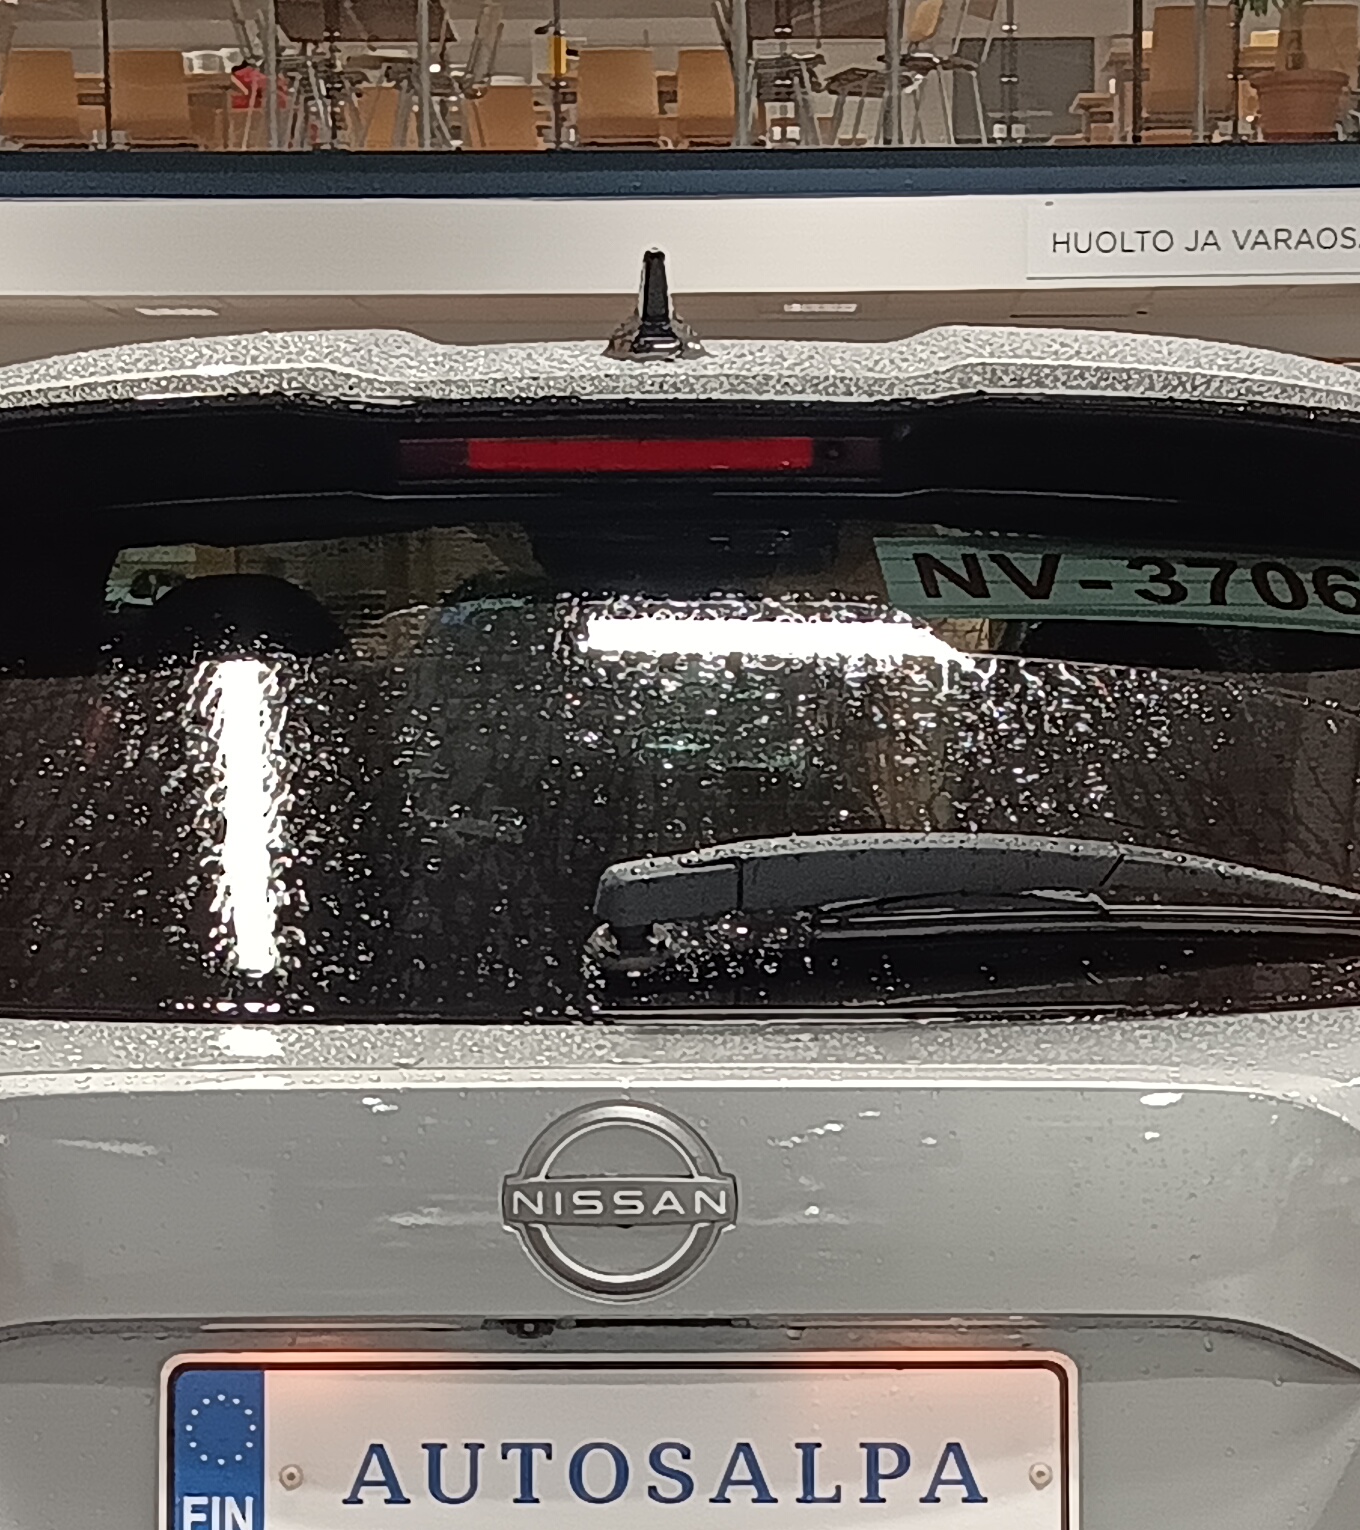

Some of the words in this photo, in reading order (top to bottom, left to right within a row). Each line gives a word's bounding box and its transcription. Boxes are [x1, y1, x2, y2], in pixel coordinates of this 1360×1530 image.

[1051, 228, 1175, 254] HUOLTO
[1184, 228, 1222, 252] JA
[512, 1190, 727, 1216] NISSAN
[341, 1440, 990, 1506] AUTOSALPA
